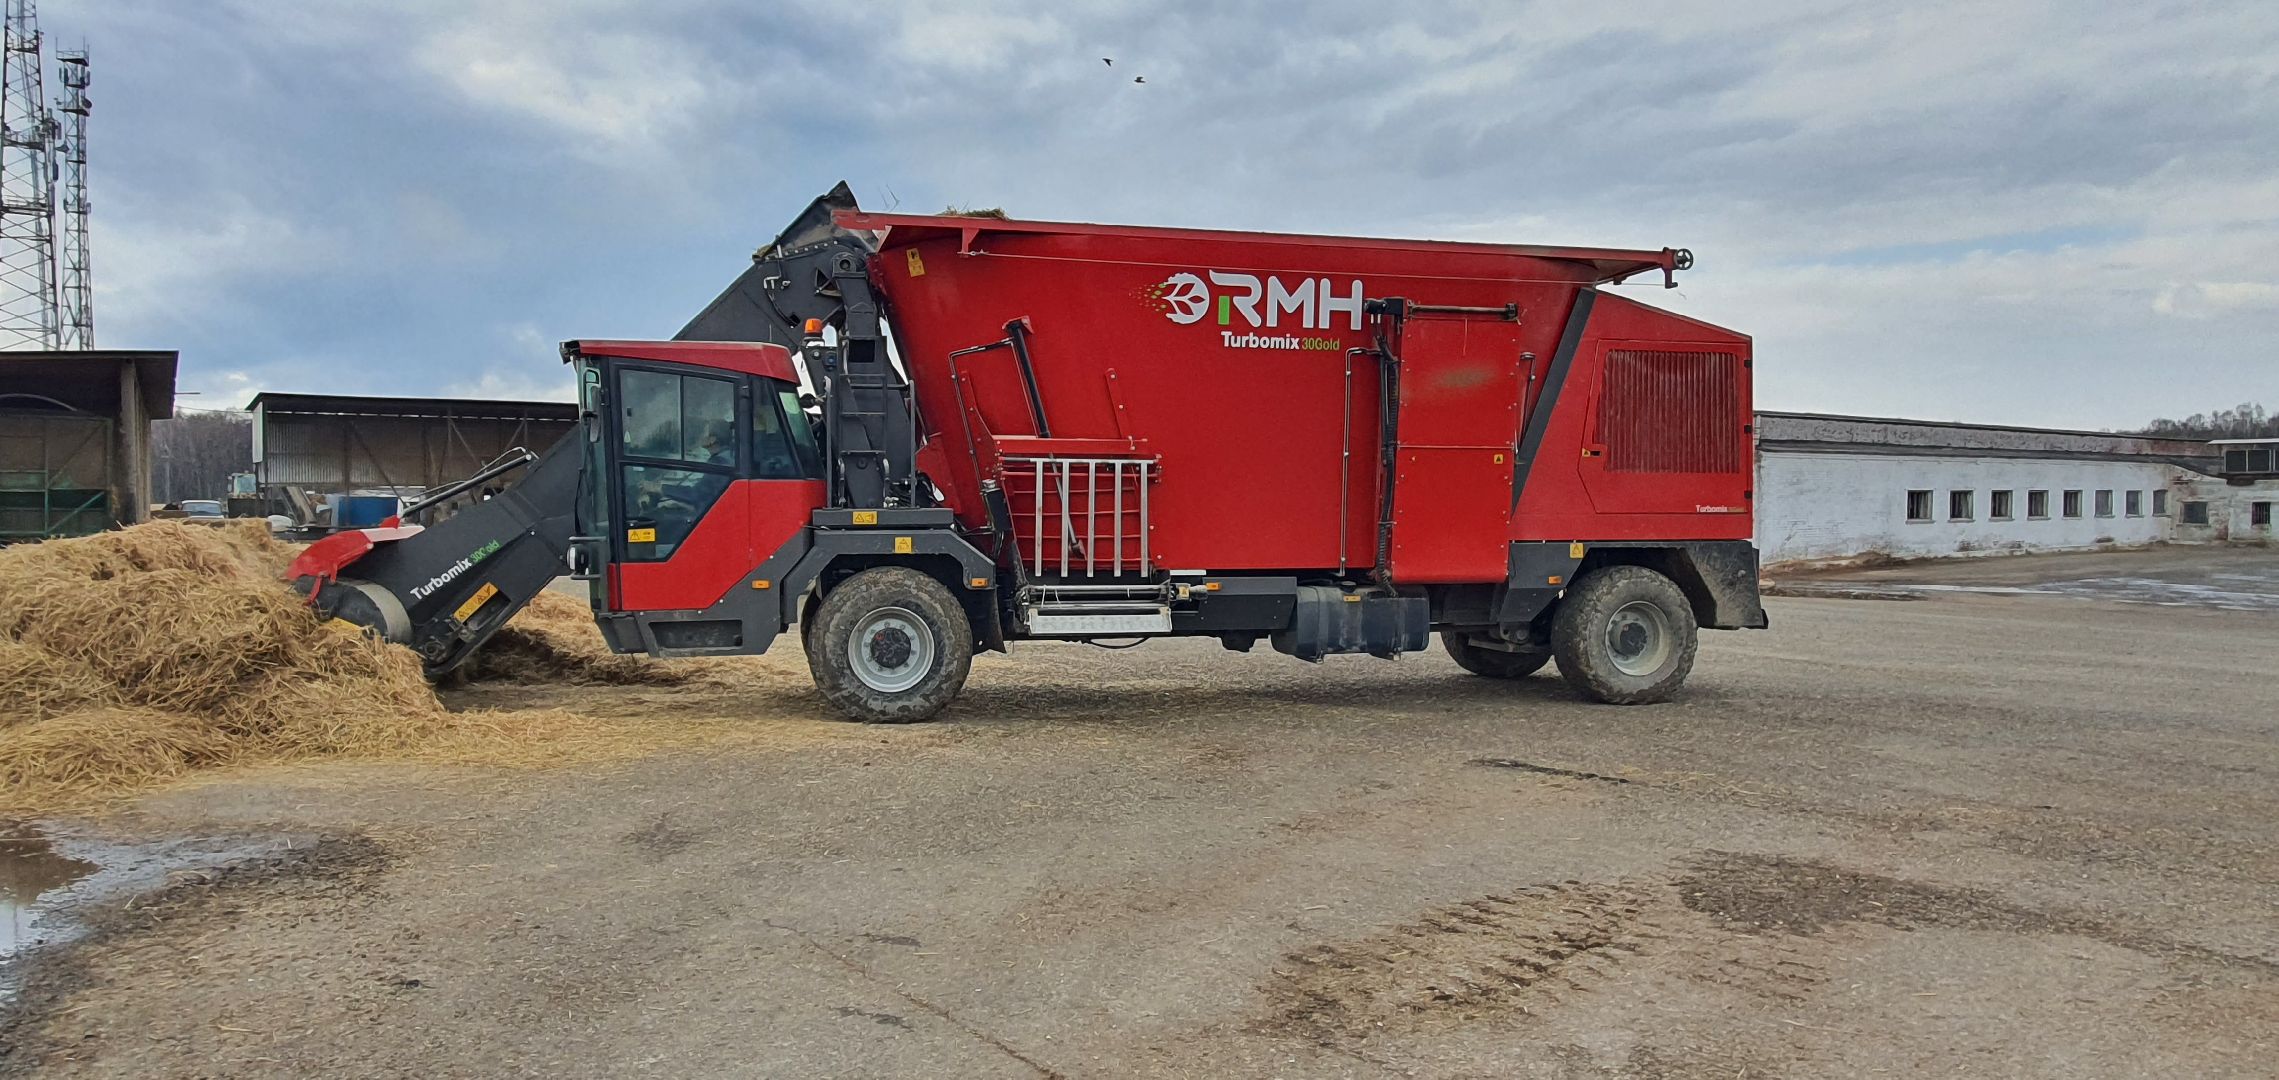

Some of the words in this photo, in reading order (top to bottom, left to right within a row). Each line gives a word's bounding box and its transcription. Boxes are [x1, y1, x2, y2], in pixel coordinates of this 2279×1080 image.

[1210, 270, 1362, 330] RMH
[1221, 331, 1300, 350] Turbomix
[1302, 337, 1340, 351] 30Gold
[410, 557, 472, 600] Turbomix
